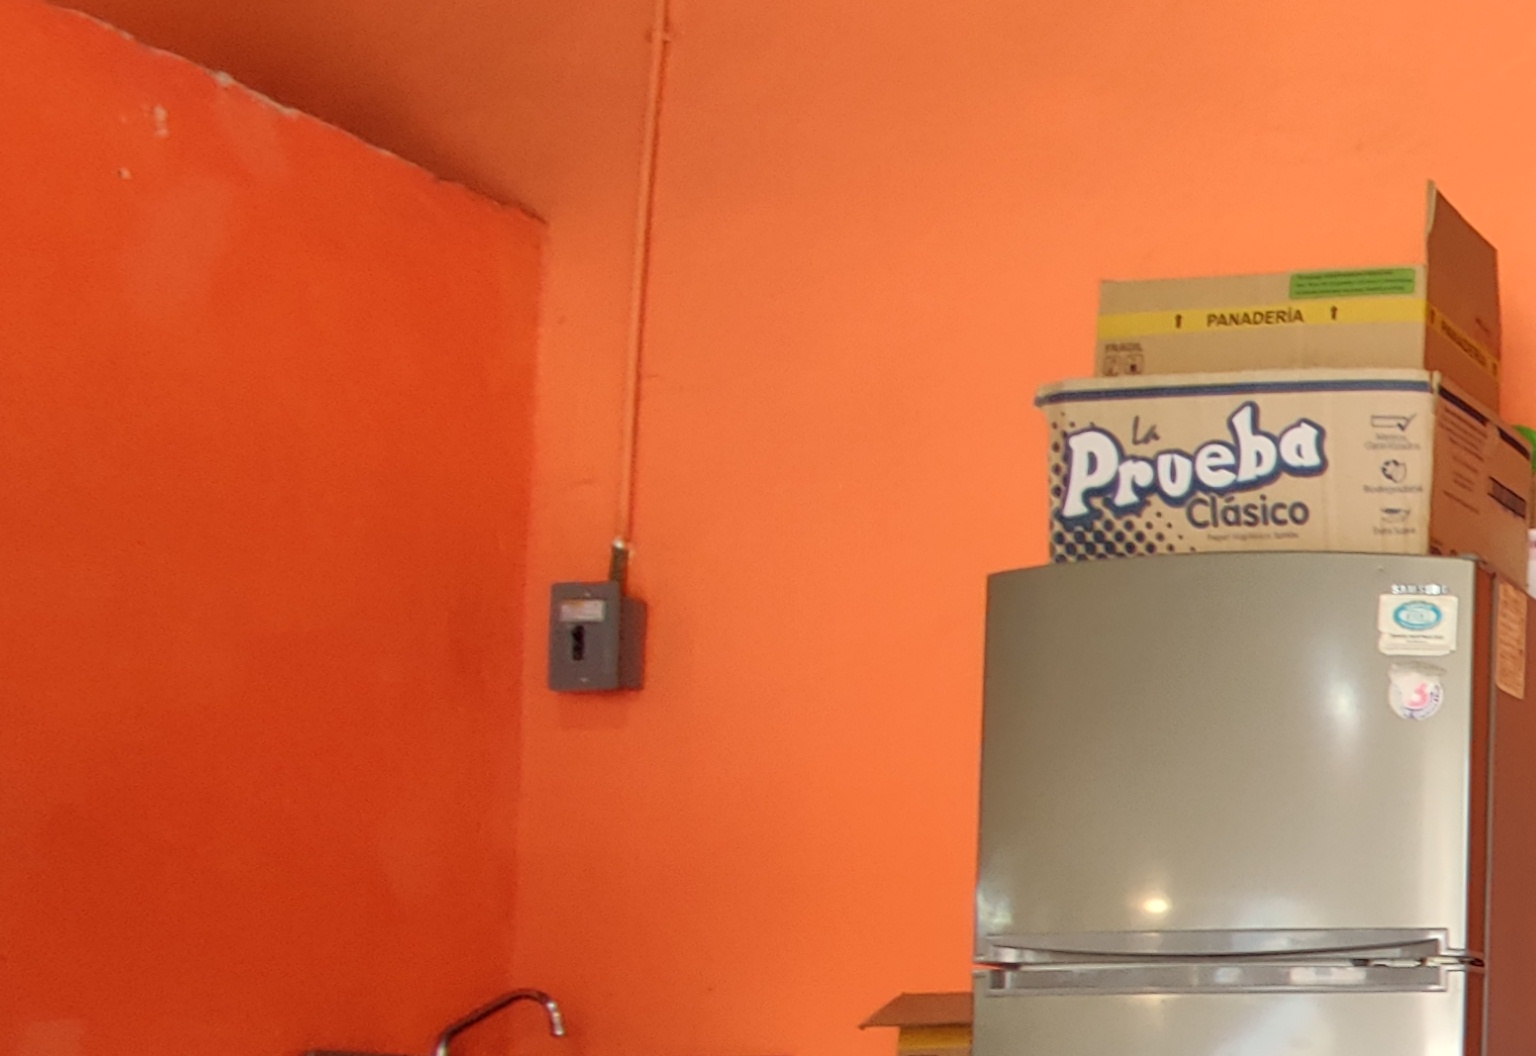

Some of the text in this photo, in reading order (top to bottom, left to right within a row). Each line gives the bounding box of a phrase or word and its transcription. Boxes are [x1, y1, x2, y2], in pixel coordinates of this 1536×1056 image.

[1206, 306, 1305, 327] PANADERÍA
[1130, 414, 1162, 447] La
[1060, 401, 1325, 520] Prueba
[1184, 494, 1311, 528] Clásico
